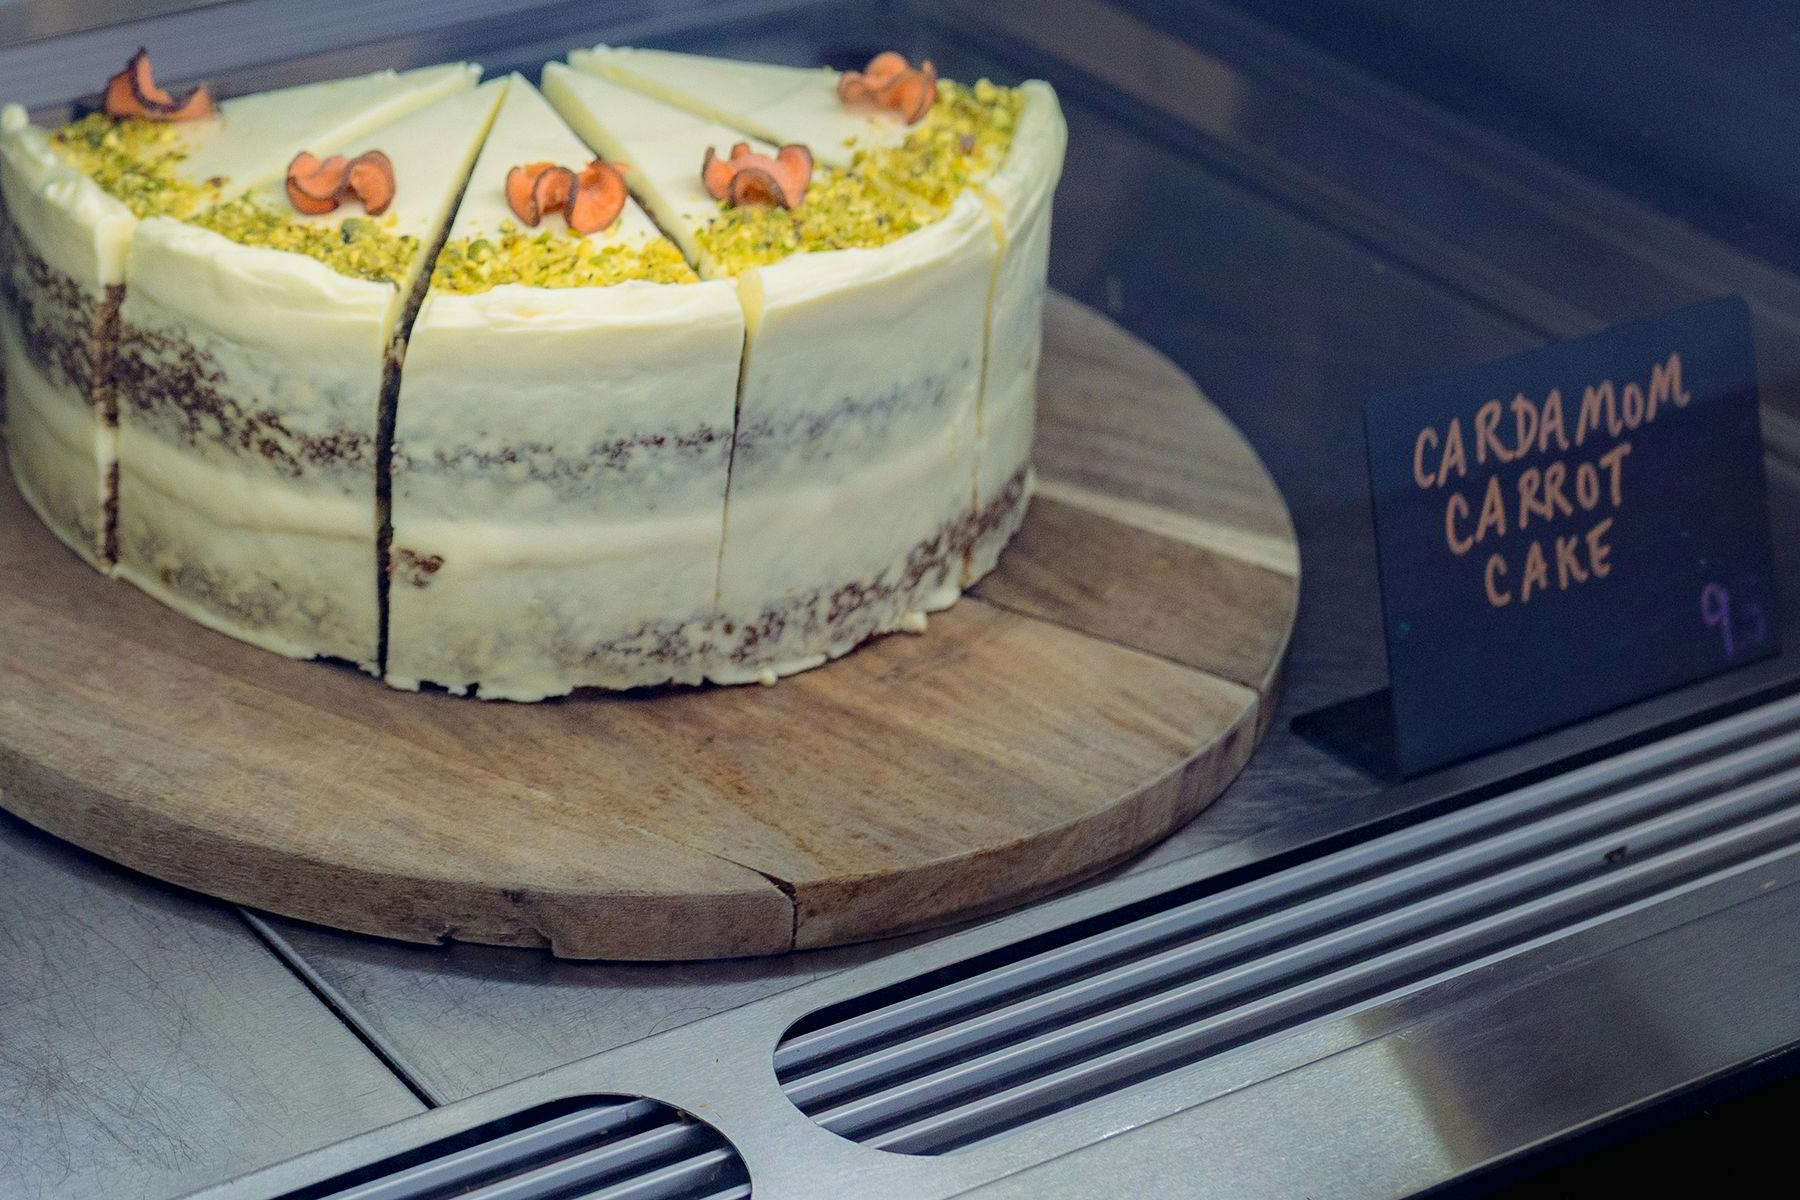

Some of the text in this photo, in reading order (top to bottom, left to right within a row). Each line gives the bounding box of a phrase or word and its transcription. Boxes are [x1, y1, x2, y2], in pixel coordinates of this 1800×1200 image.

[1413, 352, 1691, 489] CARDAMOM
[1444, 443, 1632, 555] CARROT
[1484, 517, 1614, 607] CAKE
